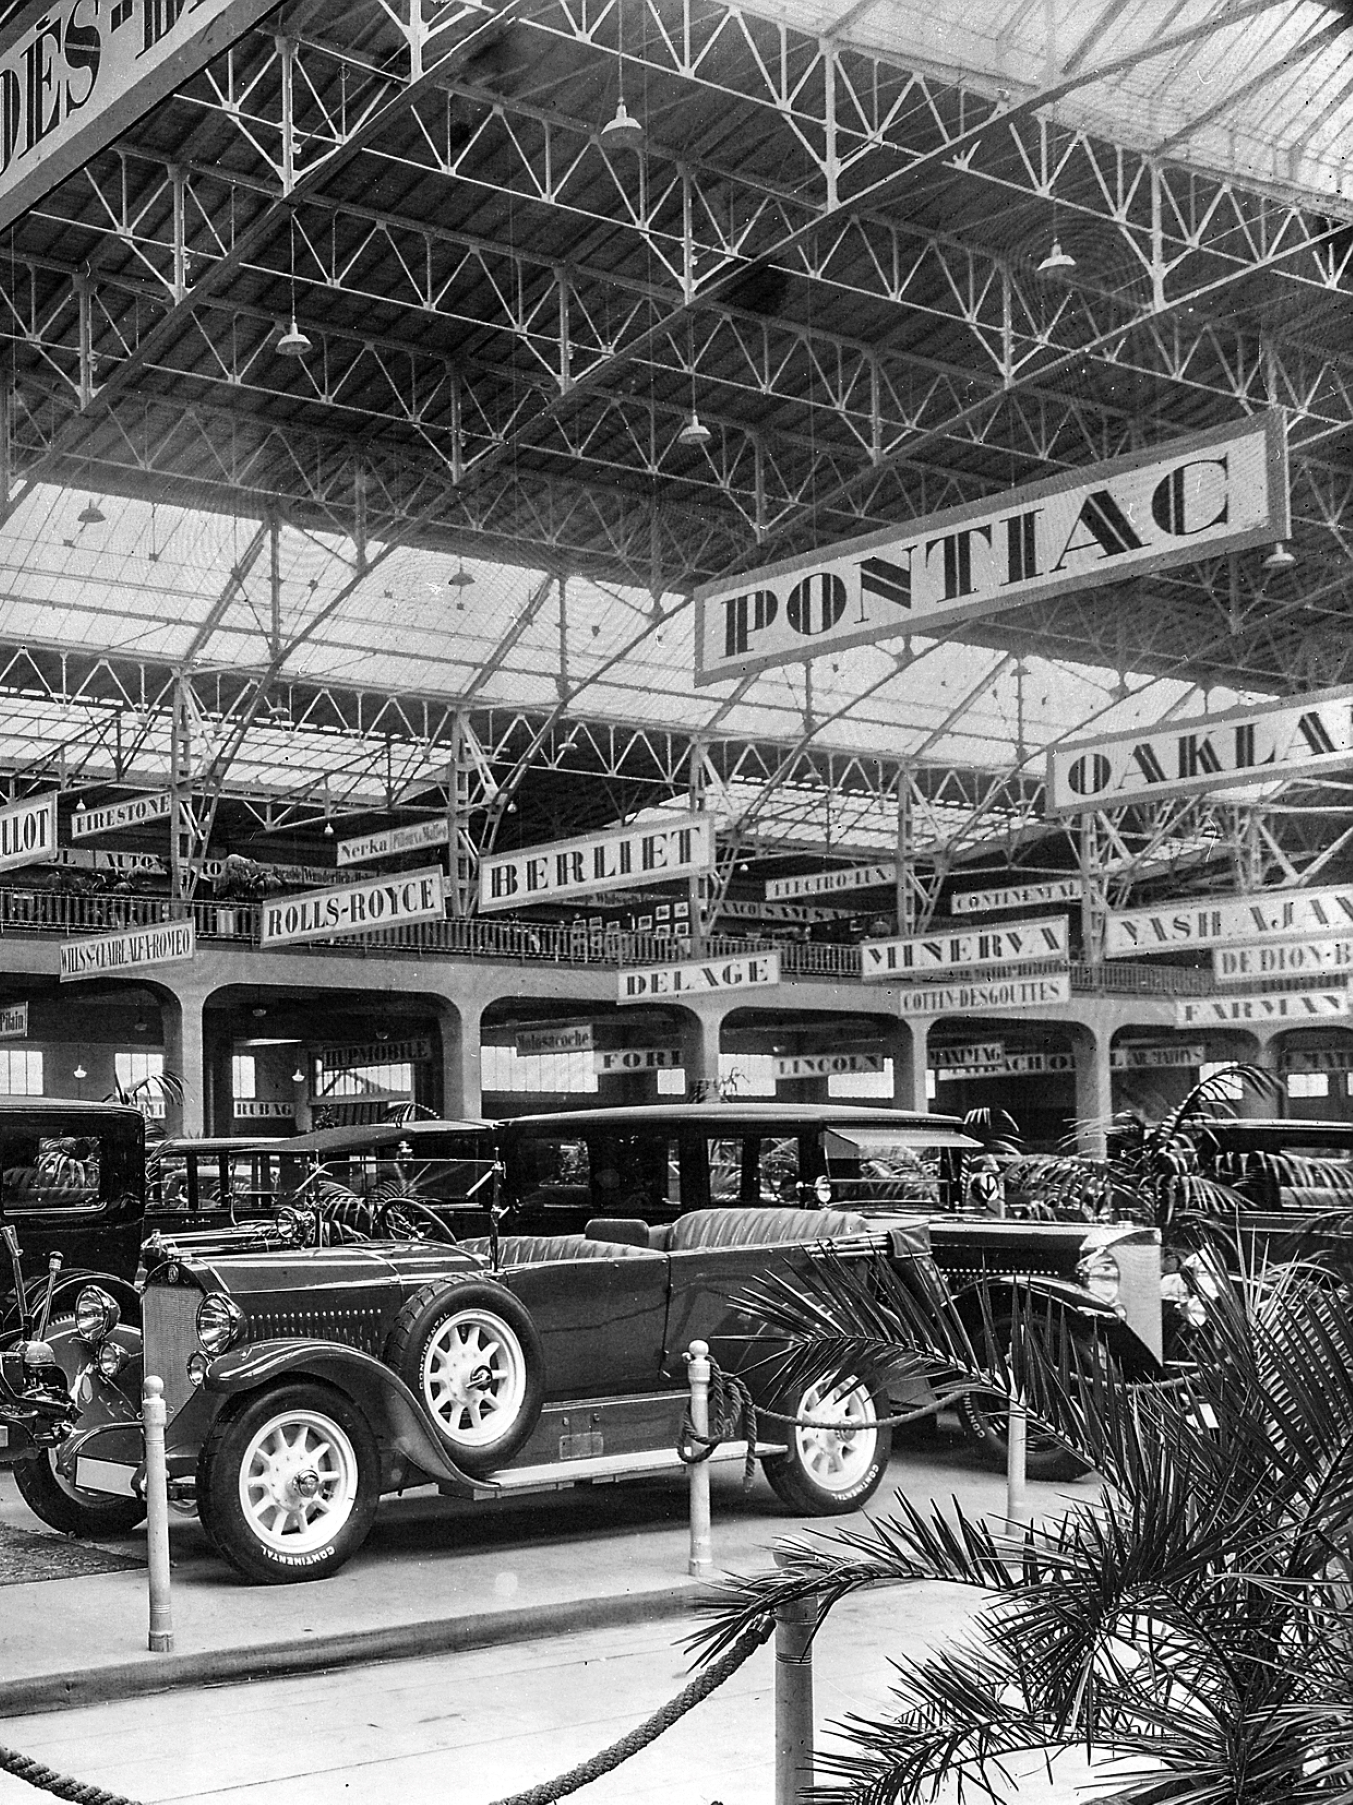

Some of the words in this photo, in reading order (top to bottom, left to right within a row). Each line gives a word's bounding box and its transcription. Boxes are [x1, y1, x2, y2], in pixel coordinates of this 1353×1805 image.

[718, 453, 1230, 660] PONTIAC
[1068, 704, 1353, 796] OAKLA
[76, 794, 170, 833] FIRESTONE
[491, 827, 700, 899] BERLIET
[268, 878, 435, 936] ROLLS-ROYCE
[130, 928, 191, 962] ALFA-ROMEO
[867, 927, 1061, 970] MINERVA
[627, 959, 769, 996] DELAGE
[903, 980, 1060, 1010] COTTIN-DESGOUTTES
[1185, 994, 1342, 1021] FARMAN
[324, 1040, 428, 1067] HUPMOBILE
[778, 1055, 879, 1075] LINCOLN
[236, 1103, 292, 1116] RUBAG
[419, 1312, 450, 1390] CONTINENTAL
[830, 1463, 879, 1501] CONTINENTAL
[260, 1545, 336, 1566] CONTINENTAL
